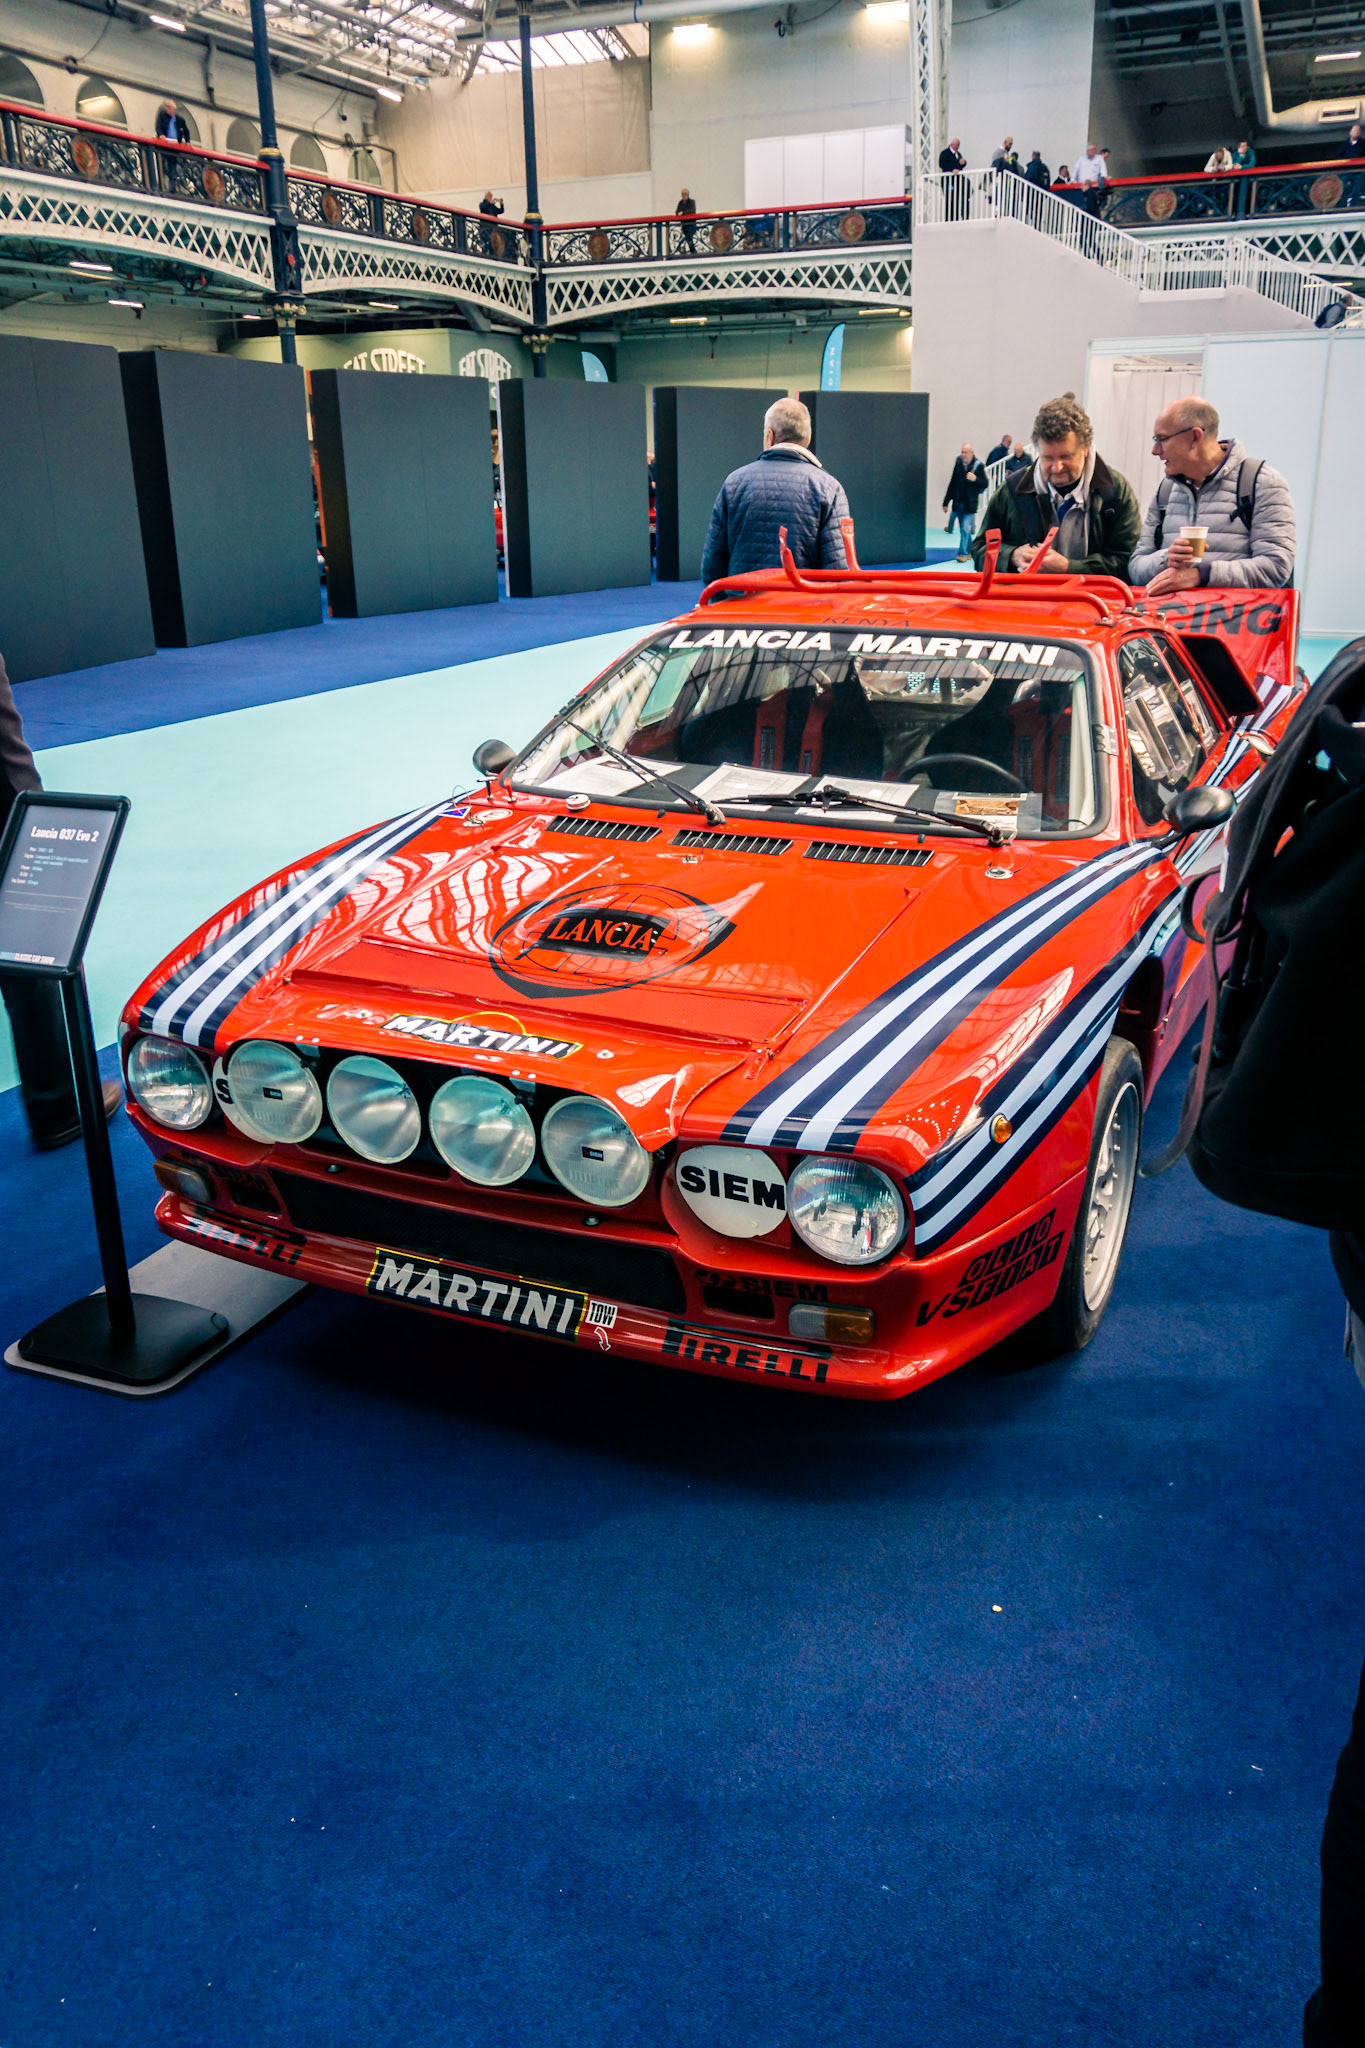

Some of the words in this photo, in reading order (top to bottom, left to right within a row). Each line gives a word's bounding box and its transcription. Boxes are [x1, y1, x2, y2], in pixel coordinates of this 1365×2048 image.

[669, 629, 832, 651] LANCIA
[847, 634, 1060, 666] MARTINI
[30, 825, 58, 839] Lancia
[59, 828, 76, 840] 037
[76, 830, 91, 841] Evo
[91, 830, 99, 842] 2
[547, 917, 654, 951] LANCIA
[383, 1016, 572, 1055] MARTINI
[680, 1165, 786, 1211] SIEM
[959, 1209, 1055, 1287] OLIO
[375, 1257, 575, 1334] MARTINI
[740, 1277, 828, 1302] SIEM
[588, 1302, 617, 1327] TOW
[661, 1318, 832, 1384] PIRELLI
